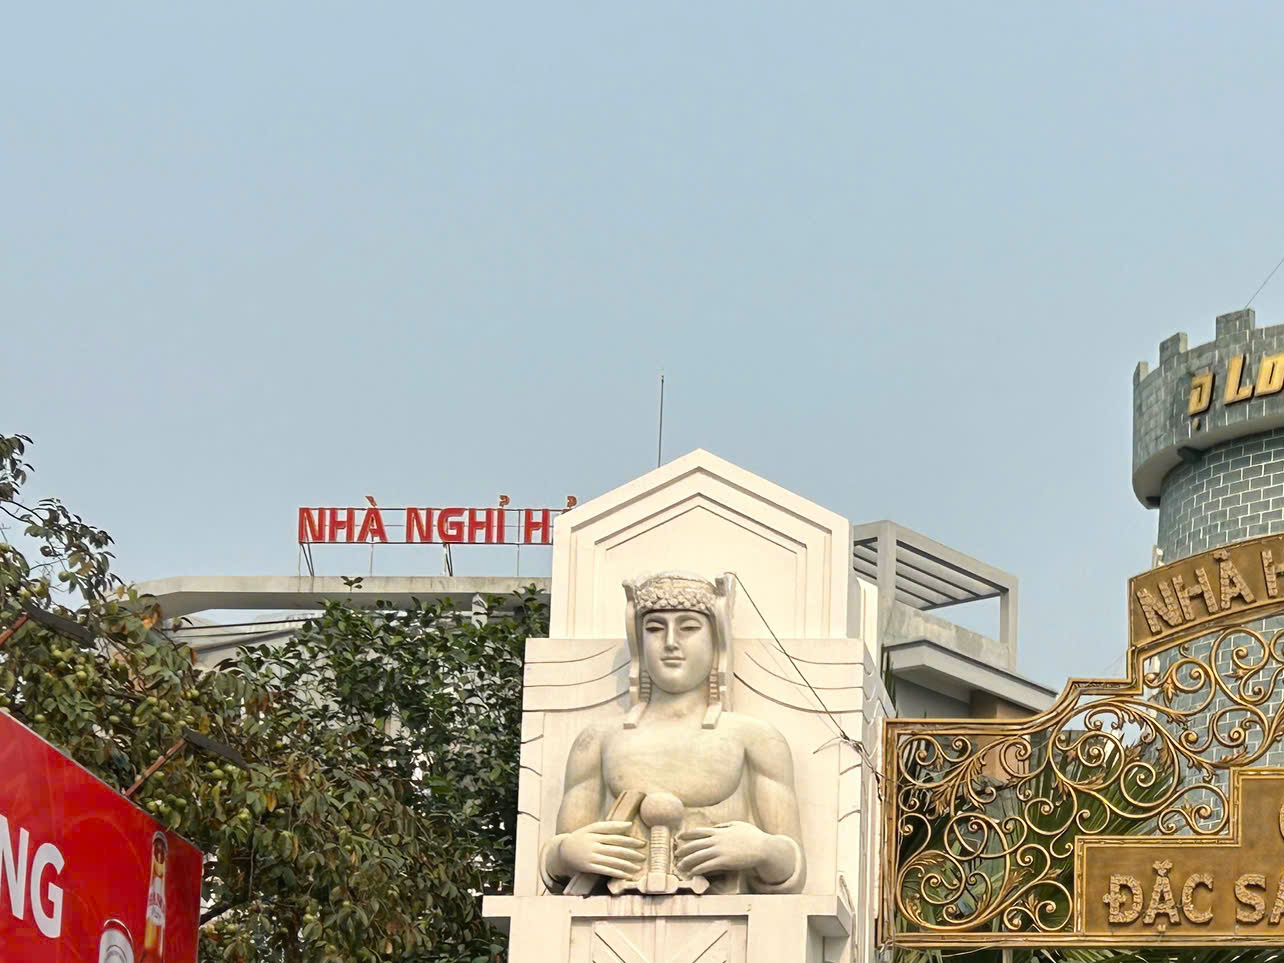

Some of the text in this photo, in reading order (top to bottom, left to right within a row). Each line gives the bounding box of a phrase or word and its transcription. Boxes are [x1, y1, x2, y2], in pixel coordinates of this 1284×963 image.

[299, 495, 577, 544] NHÀ NGHỈ H
[1136, 549, 1256, 634] NHÀ
[1102, 859, 1214, 932] ĐẶC
